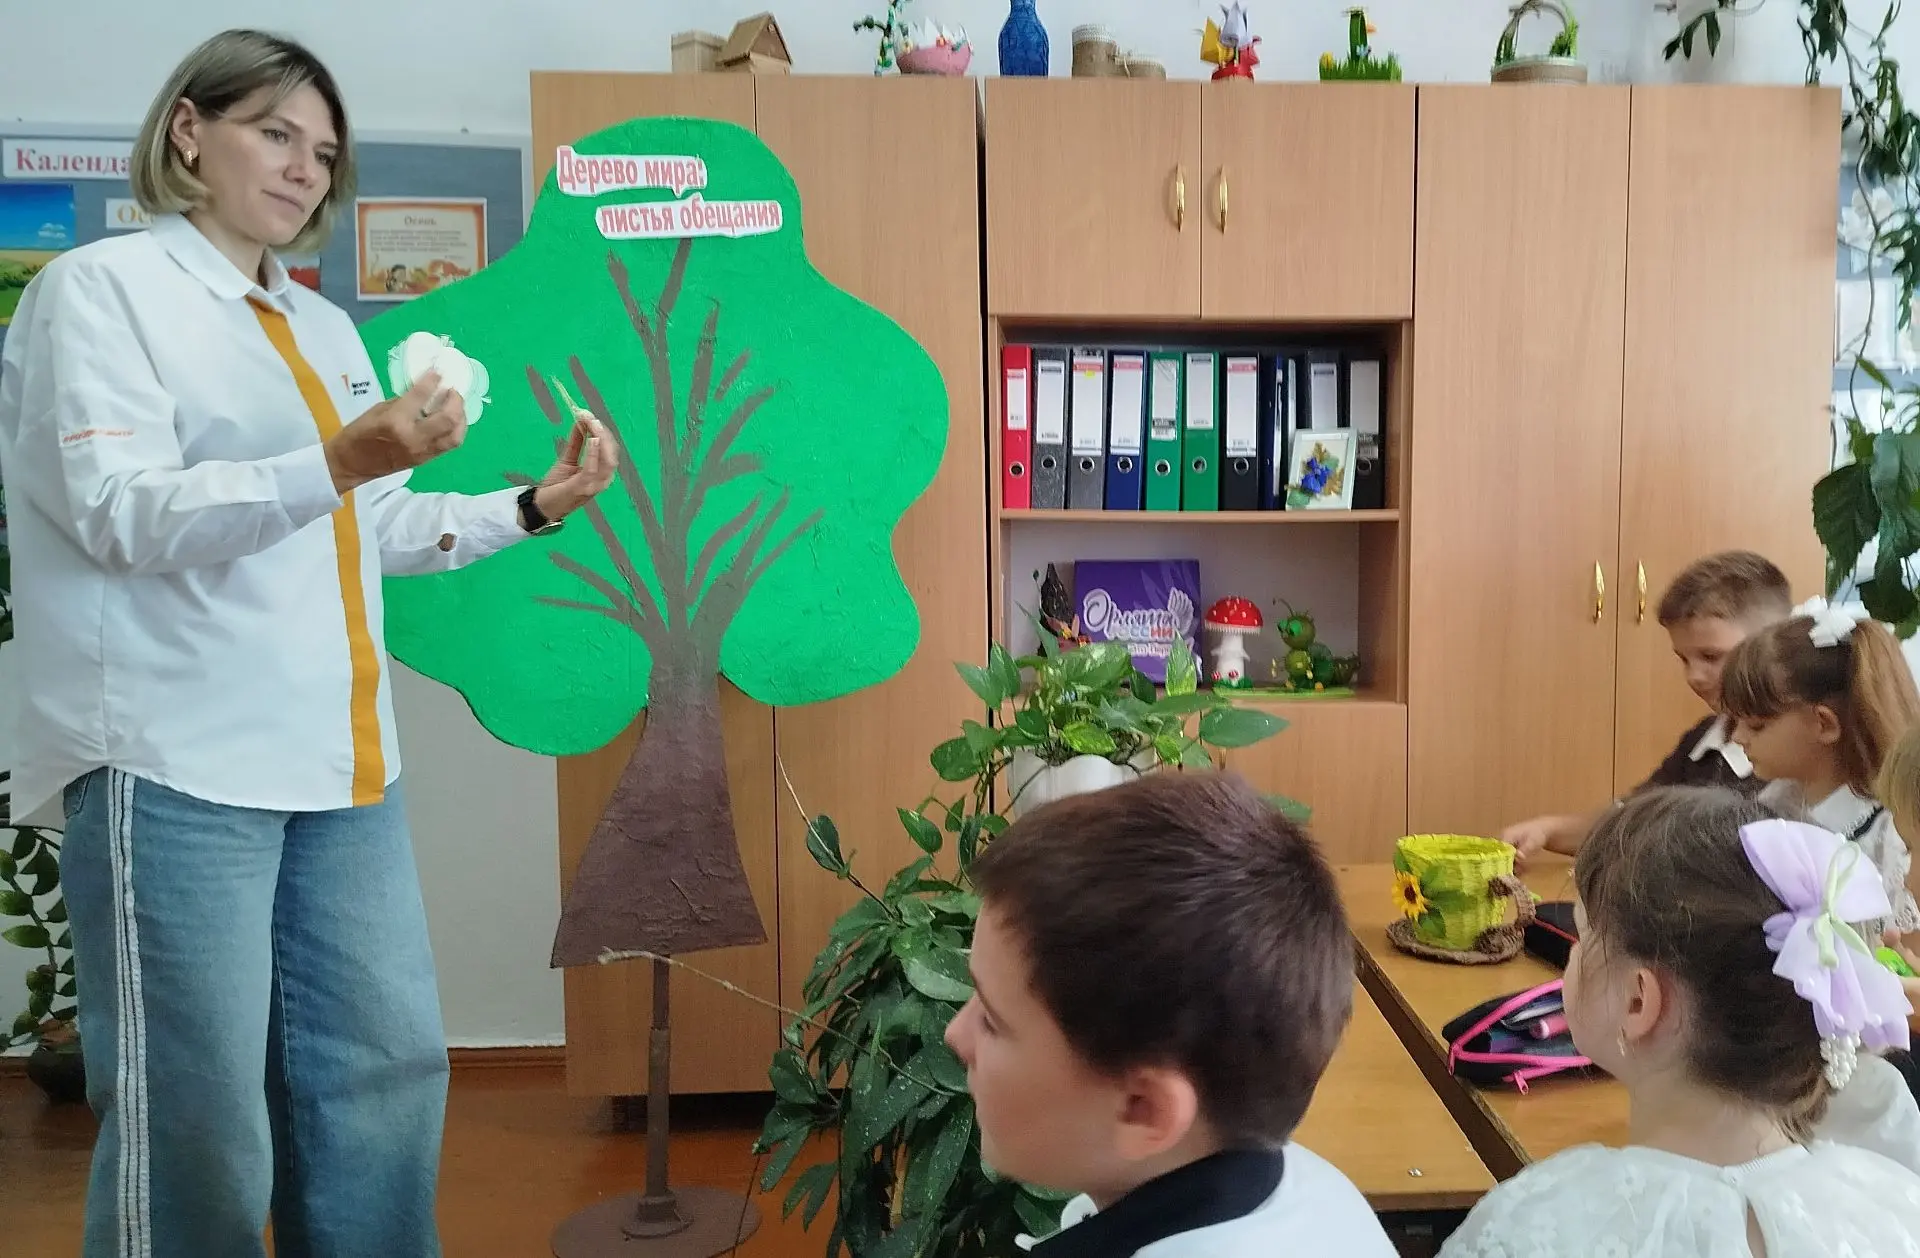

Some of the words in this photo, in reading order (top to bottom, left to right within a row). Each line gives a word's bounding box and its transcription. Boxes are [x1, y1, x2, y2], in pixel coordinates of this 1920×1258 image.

[559, 148, 639, 193] Дерево
[644, 158, 704, 195] мира:
[601, 205, 675, 233] листья
[680, 196, 781, 235] обещания
